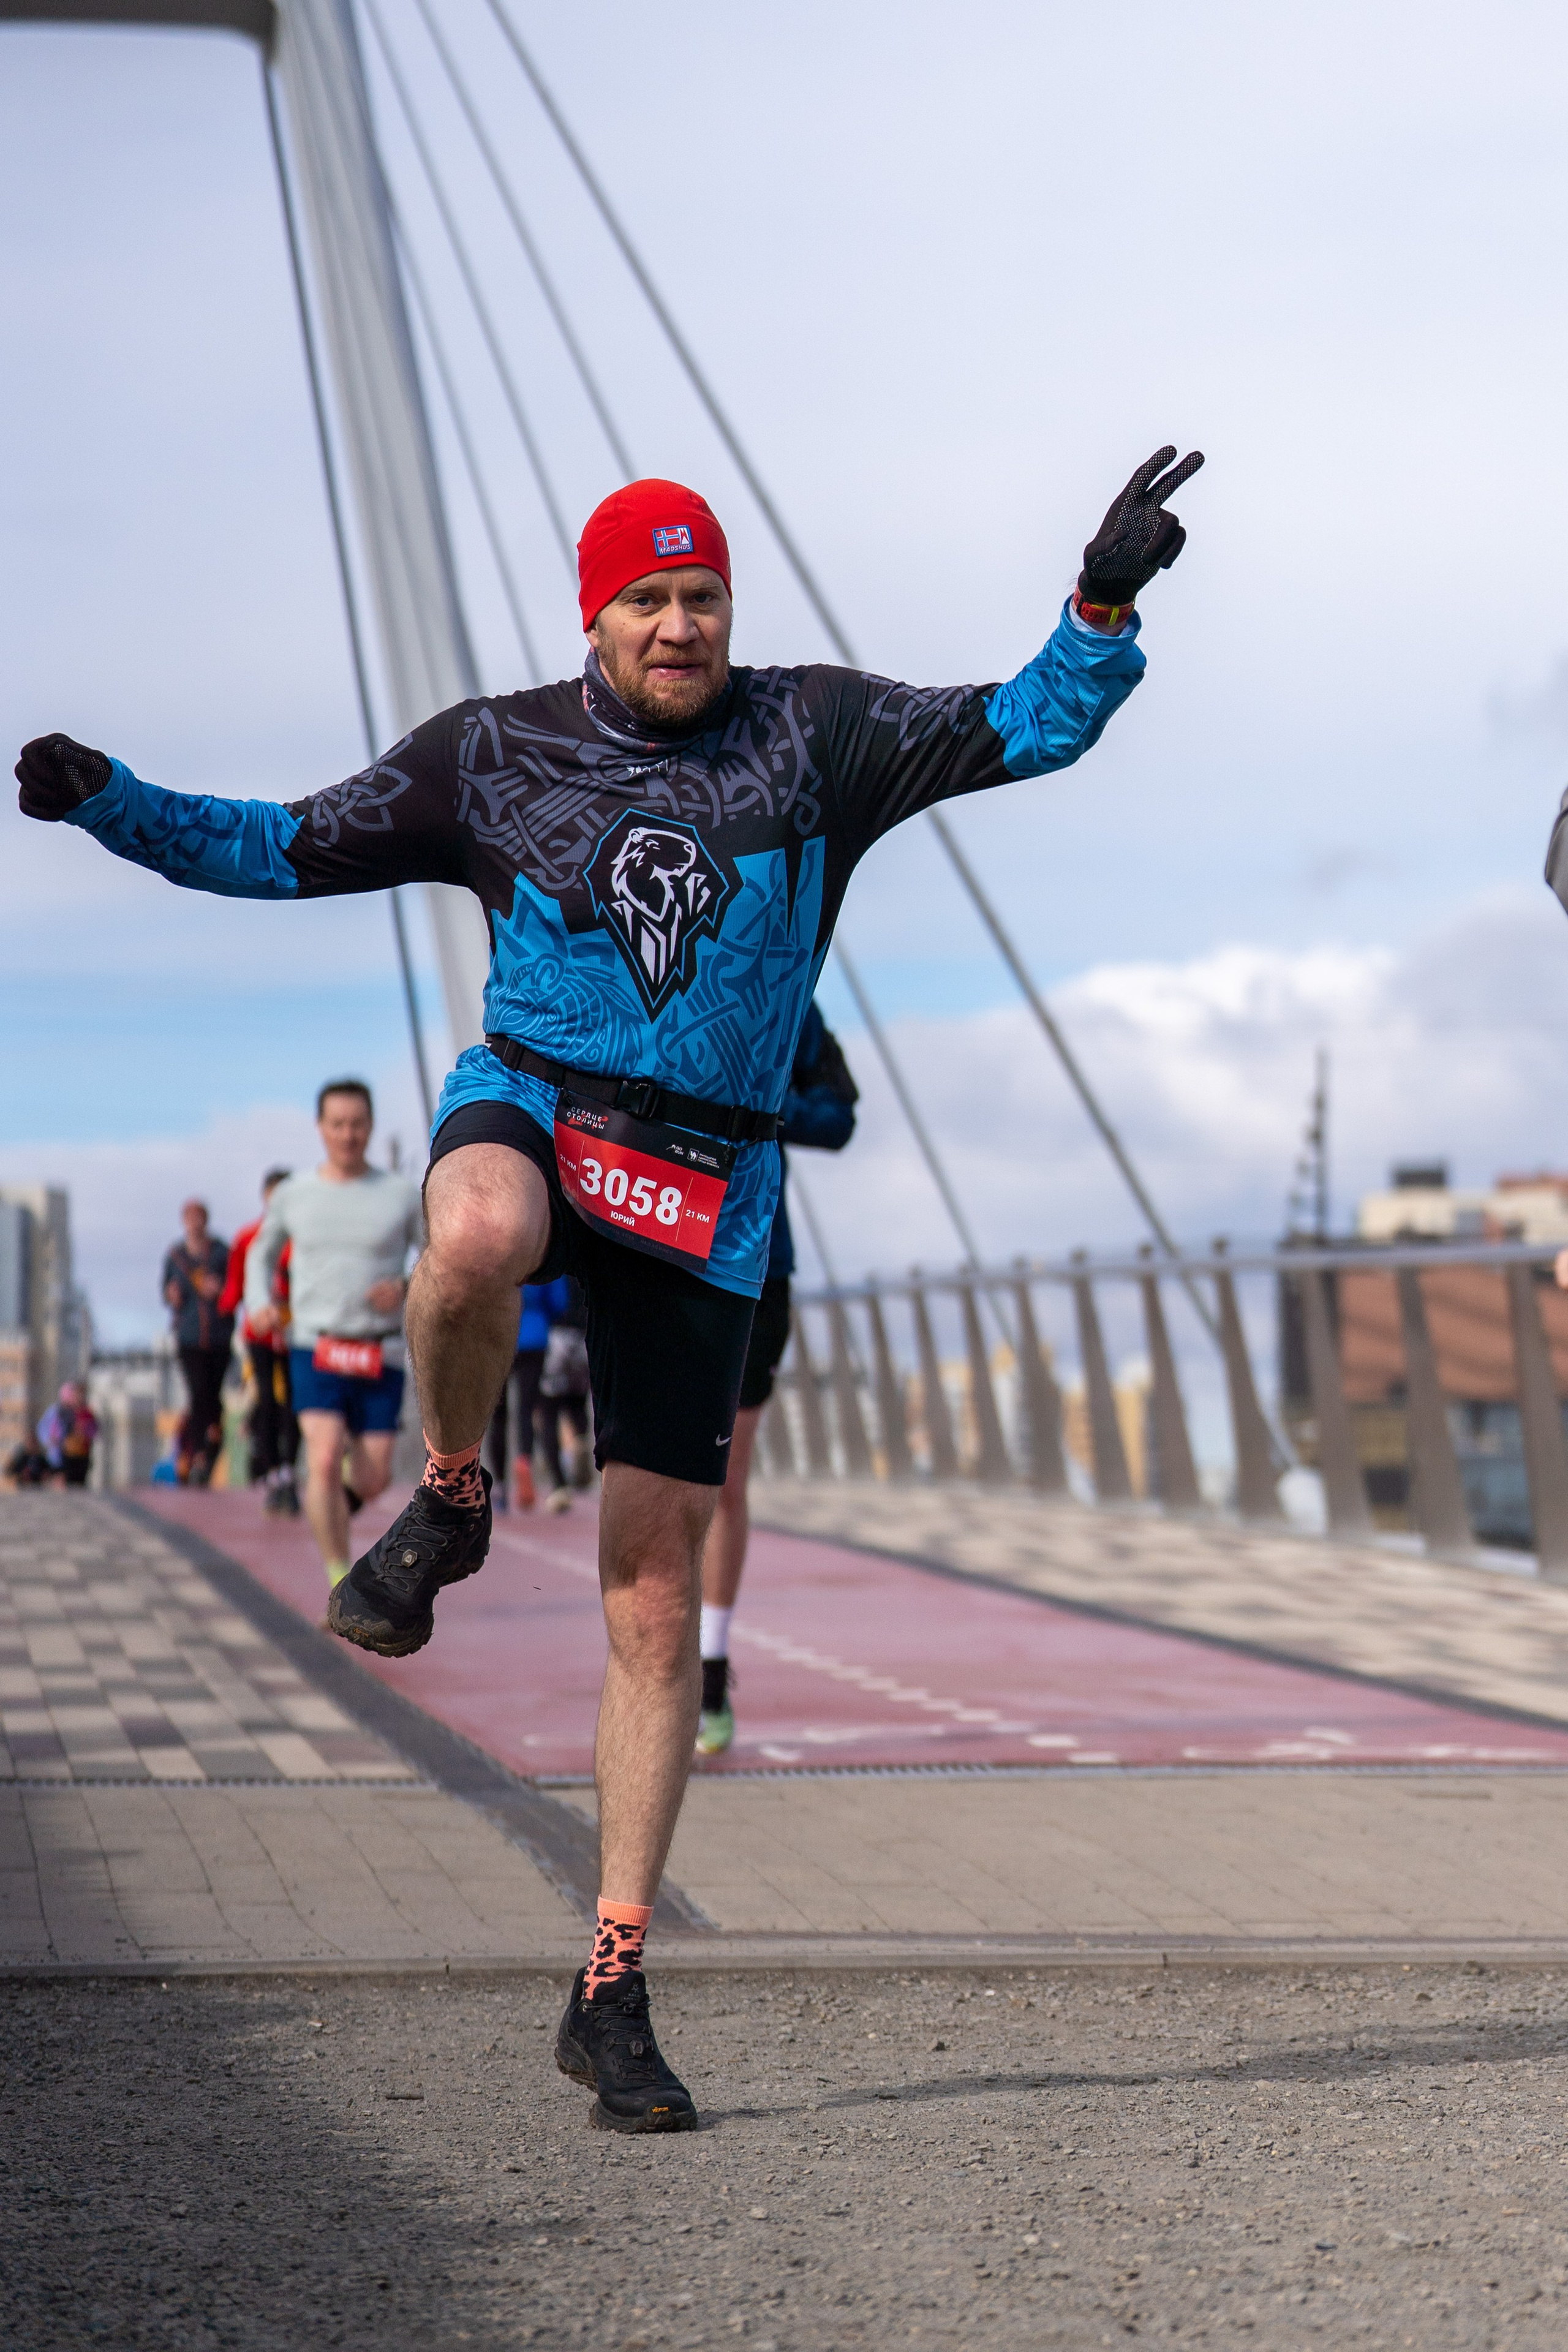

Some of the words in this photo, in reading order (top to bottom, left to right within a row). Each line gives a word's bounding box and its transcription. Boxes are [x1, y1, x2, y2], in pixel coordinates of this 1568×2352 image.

[660, 545, 691, 554] MADSHUS
[567, 1112, 605, 1129] СТОЛИЦЫ
[571, 1107, 602, 1122] СЕРДЦЕ
[560, 1153, 566, 1163] 21
[580, 1158, 682, 1226] 3058
[610, 1210, 635, 1227] ЮРИЙ
[685, 1209, 695, 1218] 21
